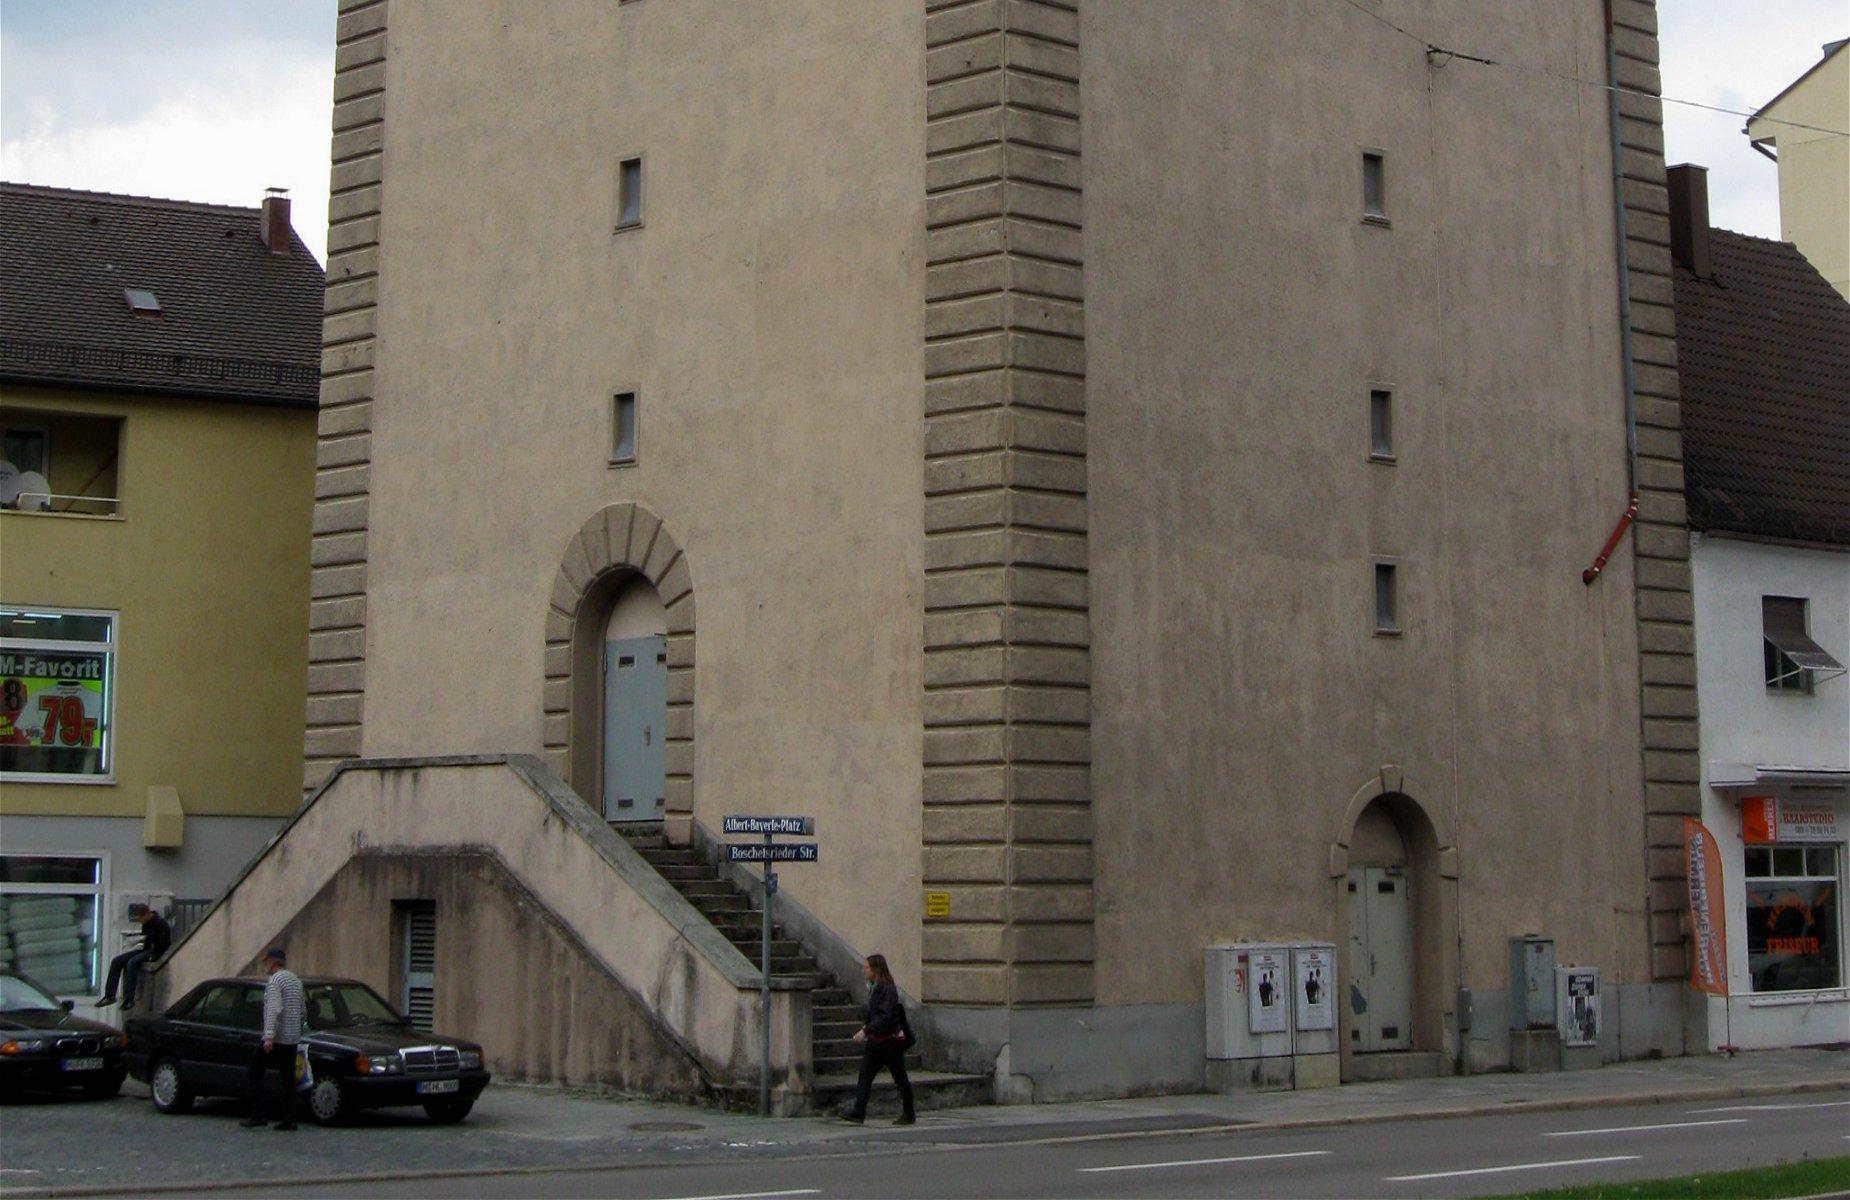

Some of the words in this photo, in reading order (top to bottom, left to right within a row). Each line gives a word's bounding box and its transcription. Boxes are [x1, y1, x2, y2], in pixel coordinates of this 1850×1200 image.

[725, 818, 801, 832] Albert-Bayerle-Platz
[731, 846, 797, 860] Boschetsrieder
[799, 846, 815, 859] Str.
[1767, 936, 1819, 956] FRISEUR
